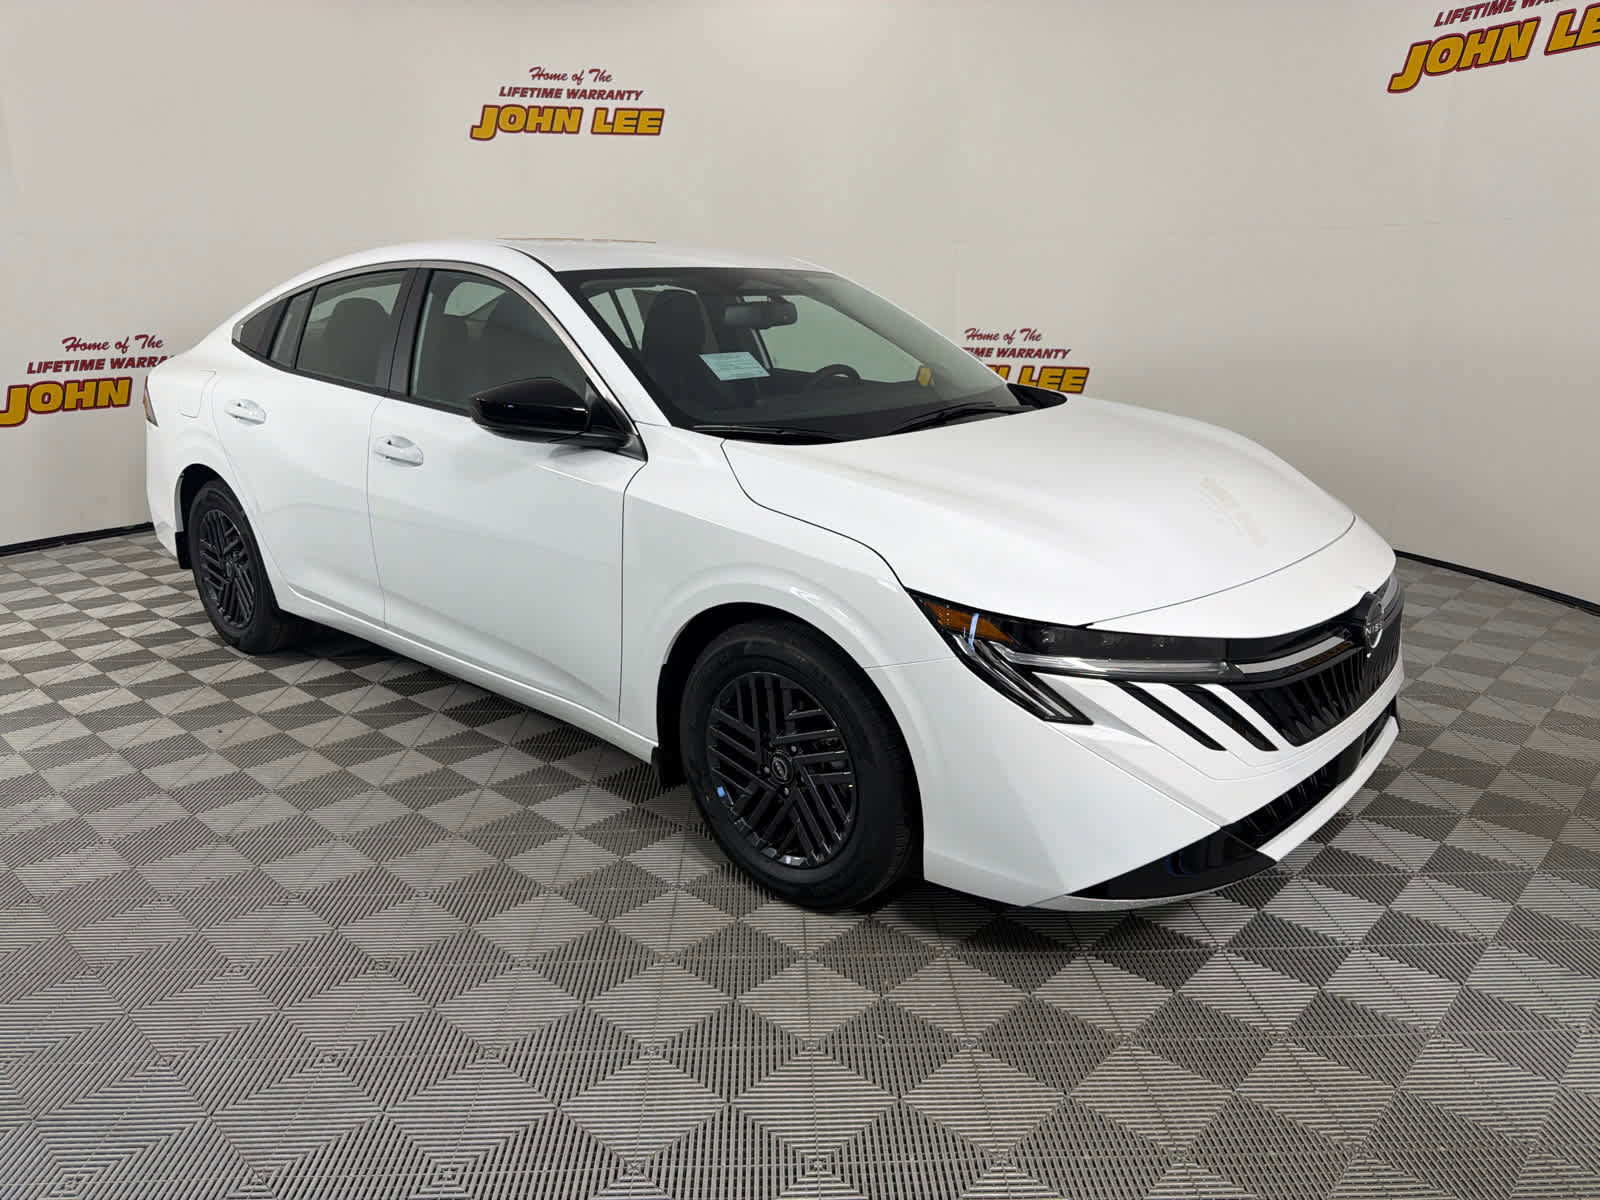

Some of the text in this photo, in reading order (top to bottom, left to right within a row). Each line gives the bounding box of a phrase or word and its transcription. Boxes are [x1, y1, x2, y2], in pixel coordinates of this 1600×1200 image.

[1433, 0, 1516, 27] LIFETIME
[1387, 16, 1541, 93] JOHN
[529, 66, 613, 85] Home of The
[499, 86, 644, 101] LIFETIME WARRANTY
[470, 104, 665, 141] JOHN LEE
[61, 334, 164, 354] Home of The
[964, 328, 1042, 345] Home of The
[996, 347, 1072, 360] WARRANTY
[27, 358, 105, 375] LIFETIME
[1017, 365, 1090, 395] LEE
[0, 376, 133, 428] JOHN
